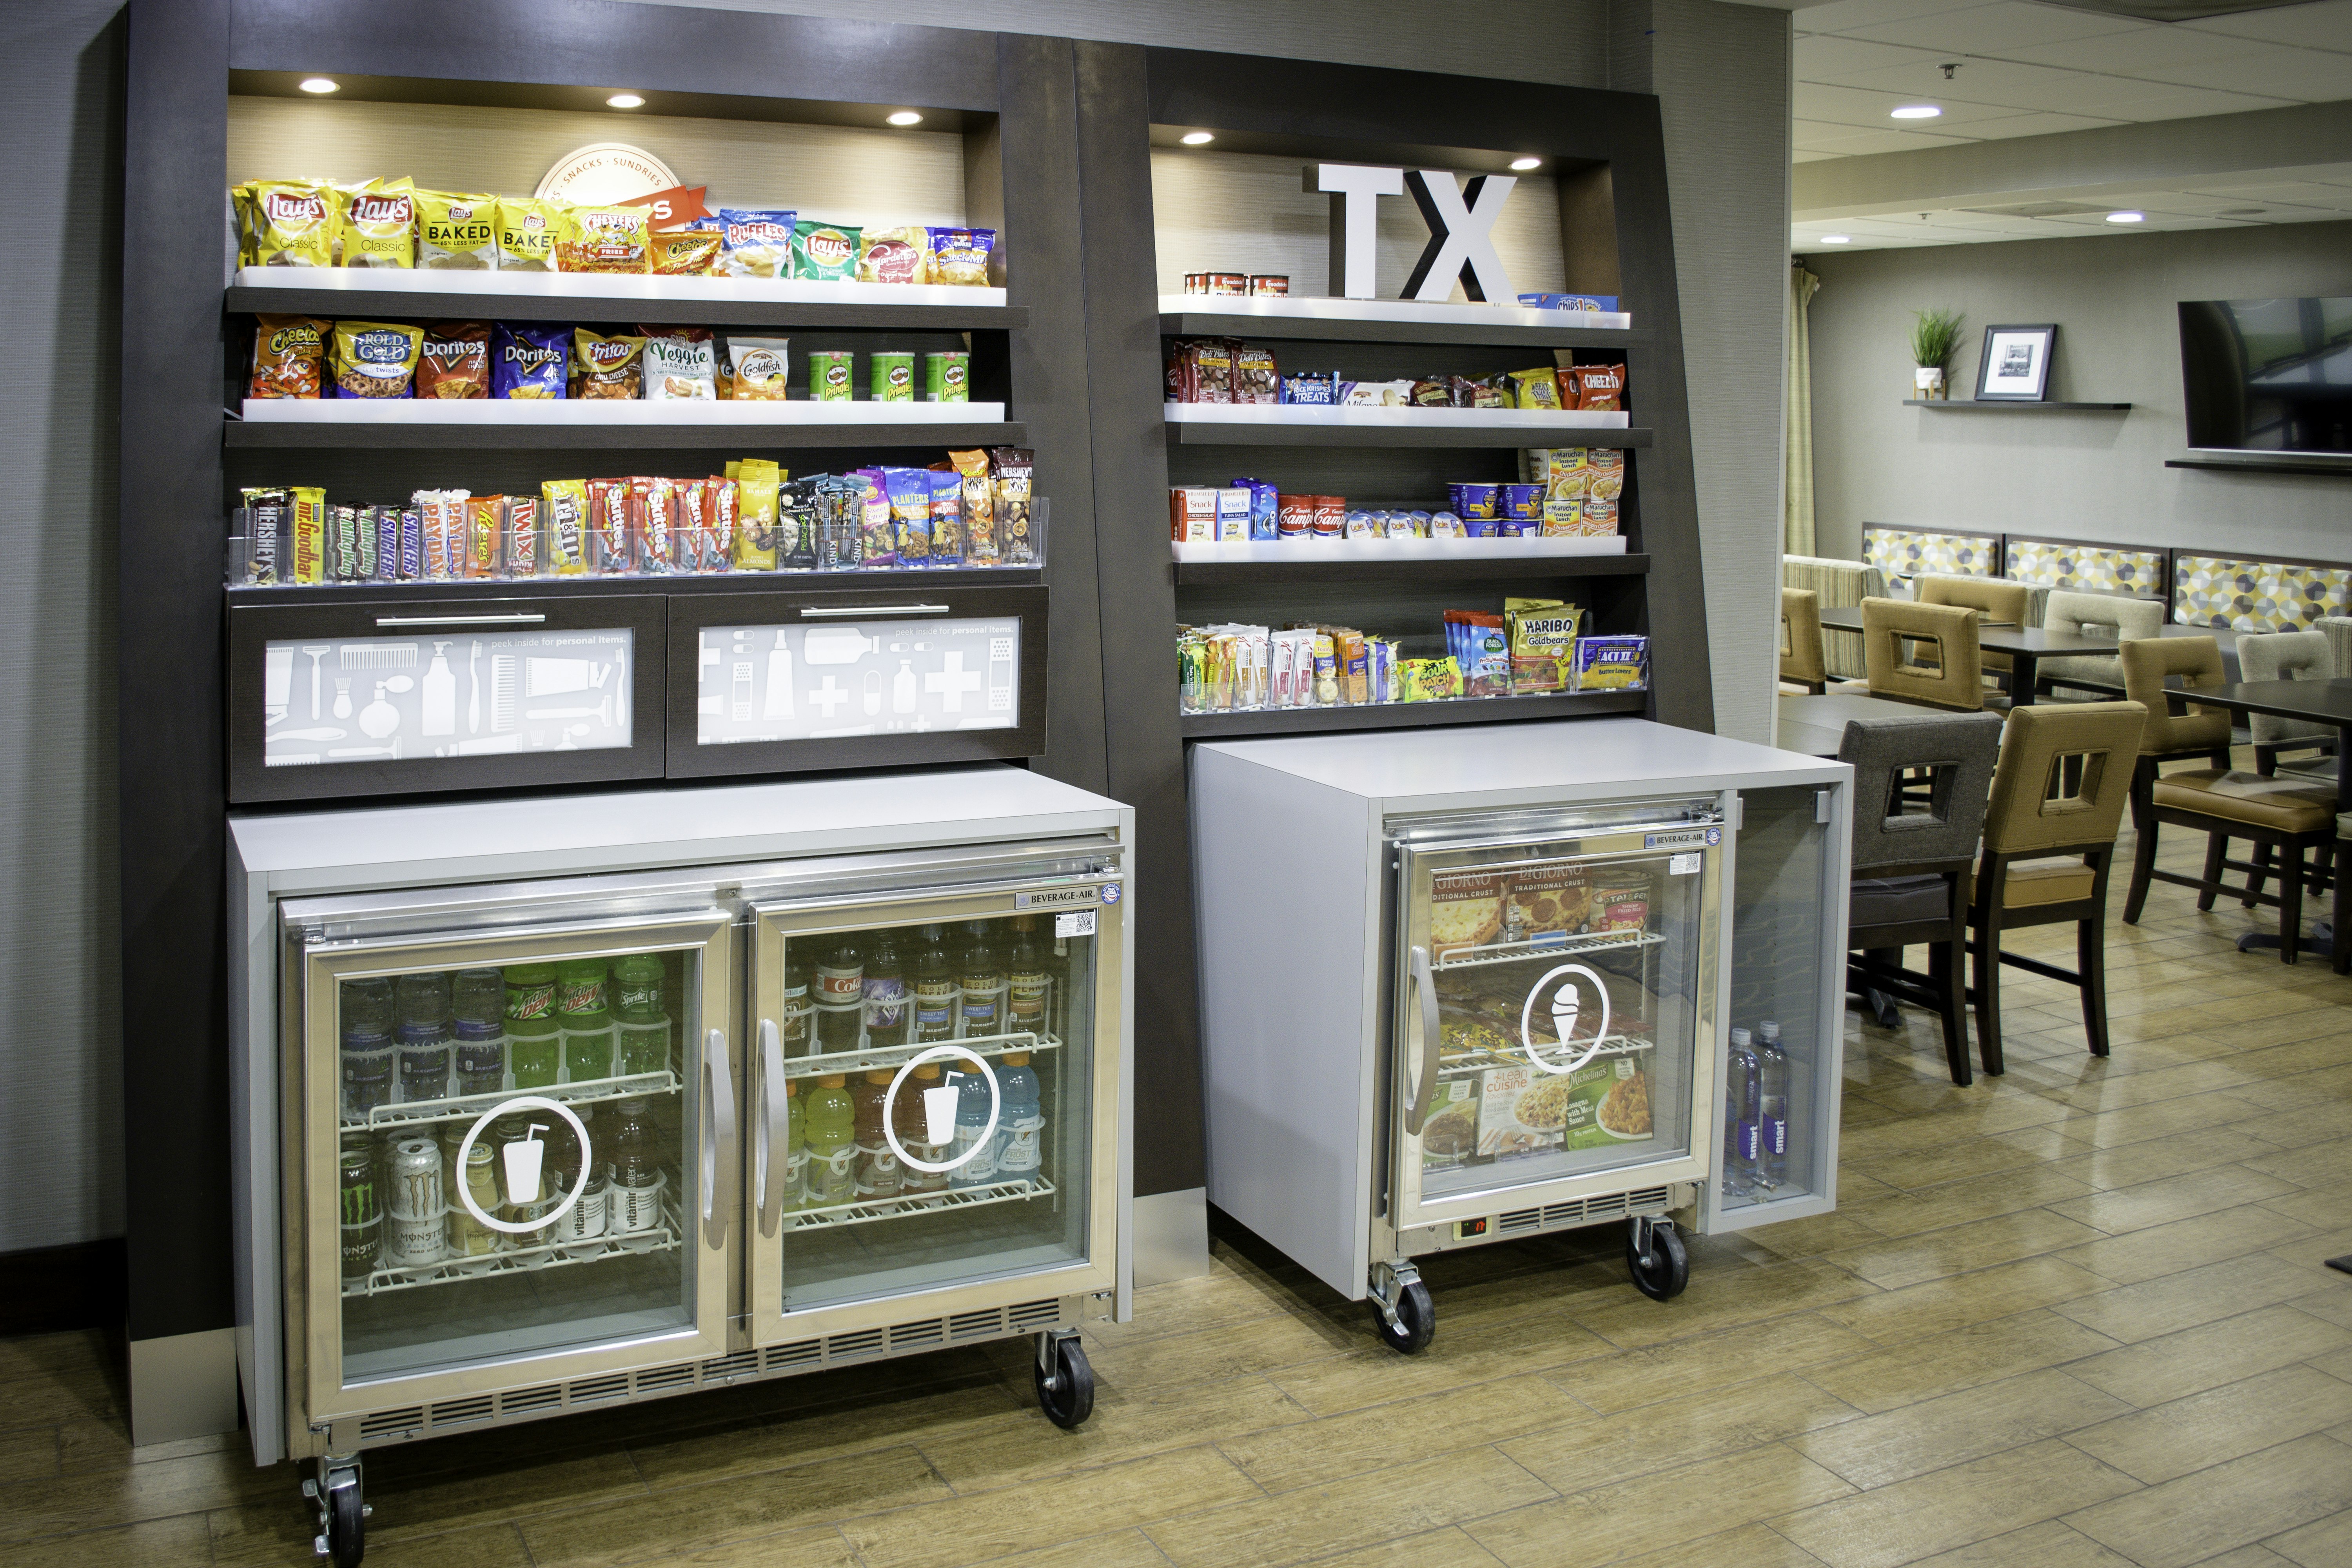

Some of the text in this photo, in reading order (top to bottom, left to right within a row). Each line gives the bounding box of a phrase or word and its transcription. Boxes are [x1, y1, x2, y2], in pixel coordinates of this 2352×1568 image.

[563, 157, 662, 186] SNACKS SUNDRIES
[271, 194, 320, 221] Lay's
[354, 197, 409, 223] Lay's
[450, 208, 471, 218] Lay's
[525, 216, 545, 227] Lay's
[585, 214, 639, 234] CHESTER'S
[429, 226, 490, 239] BAKED
[504, 232, 556, 247] BAKE
[730, 223, 785, 244] RUFFLES
[1309, 163, 1518, 303] TX
[279, 237, 318, 250] Classic
[361, 240, 405, 252] Classic
[669, 238, 707, 258] Cheetos
[810, 236, 849, 257] Lay's
[270, 325, 320, 354] Cheetos
[365, 334, 404, 346] ROLD
[360, 345, 405, 359] GOLD
[424, 341, 486, 356] Doritos
[506, 346, 561, 362] Doritos
[588, 341, 631, 361] Fritos
[650, 341, 709, 365] Veggie
[1200, 349, 1229, 358] Deli Bites
[1239, 353, 1254, 362] Deli
[609, 367, 629, 380] CHEESE
[662, 362, 700, 371] HARVEST
[744, 360, 780, 377] Goldfish
[825, 382, 850, 401] Pringles
[887, 382, 911, 402] Pringles
[943, 381, 967, 401] Pringles
[1531, 382, 1549, 392] WHEAT
[1295, 393, 1330, 403] TREATS
[1001, 467, 1033, 477] HERSHEY'S
[892, 494, 929, 505] PLANTERS
[1224, 500, 1246, 508] Snack
[867, 506, 886, 515] Sweet
[608, 488, 625, 550] Skittles
[648, 492, 668, 553] Skittles
[719, 490, 733, 549] Skittles
[799, 514, 807, 551] PISTACHIOS
[1350, 523, 1364, 532] Dole
[257, 506, 277, 574] HERSHEY'S
[403, 513, 418, 576] SNICKERS
[380, 517, 397, 578] SNICKERS
[853, 539, 862, 561] KIND
[896, 628, 913, 637] peek
[952, 626, 987, 635] personal
[1525, 619, 1573, 633] HARIBO
[492, 639, 512, 649] peek
[515, 638, 539, 647] inside
[542, 638, 554, 646] for
[556, 636, 596, 647] personal
[1529, 637, 1568, 645] Goldbears
[1601, 651, 1632, 662] ACT II
[1421, 664, 1448, 679] SOUR
[1419, 673, 1450, 690] PATCH
[1657, 833, 1702, 844] BEVERAGE-AIR
[1514, 879, 1585, 892] TRADITIONAL CRUST
[1031, 890, 1093, 903] BEVERAGE-AIR
[835, 979, 862, 993] Coke
[622, 991, 645, 1005] Sprite
[1568, 1067, 1607, 1089] Michelina's
[1485, 1091, 1515, 1102] favorites
[1567, 1105, 1594, 1118] with Meat
[1568, 1116, 1585, 1125] Sauce
[1749, 1125, 1758, 1160] smart
[1775, 1120, 1784, 1154] smart
[1005, 1149, 1030, 1158] FROST
